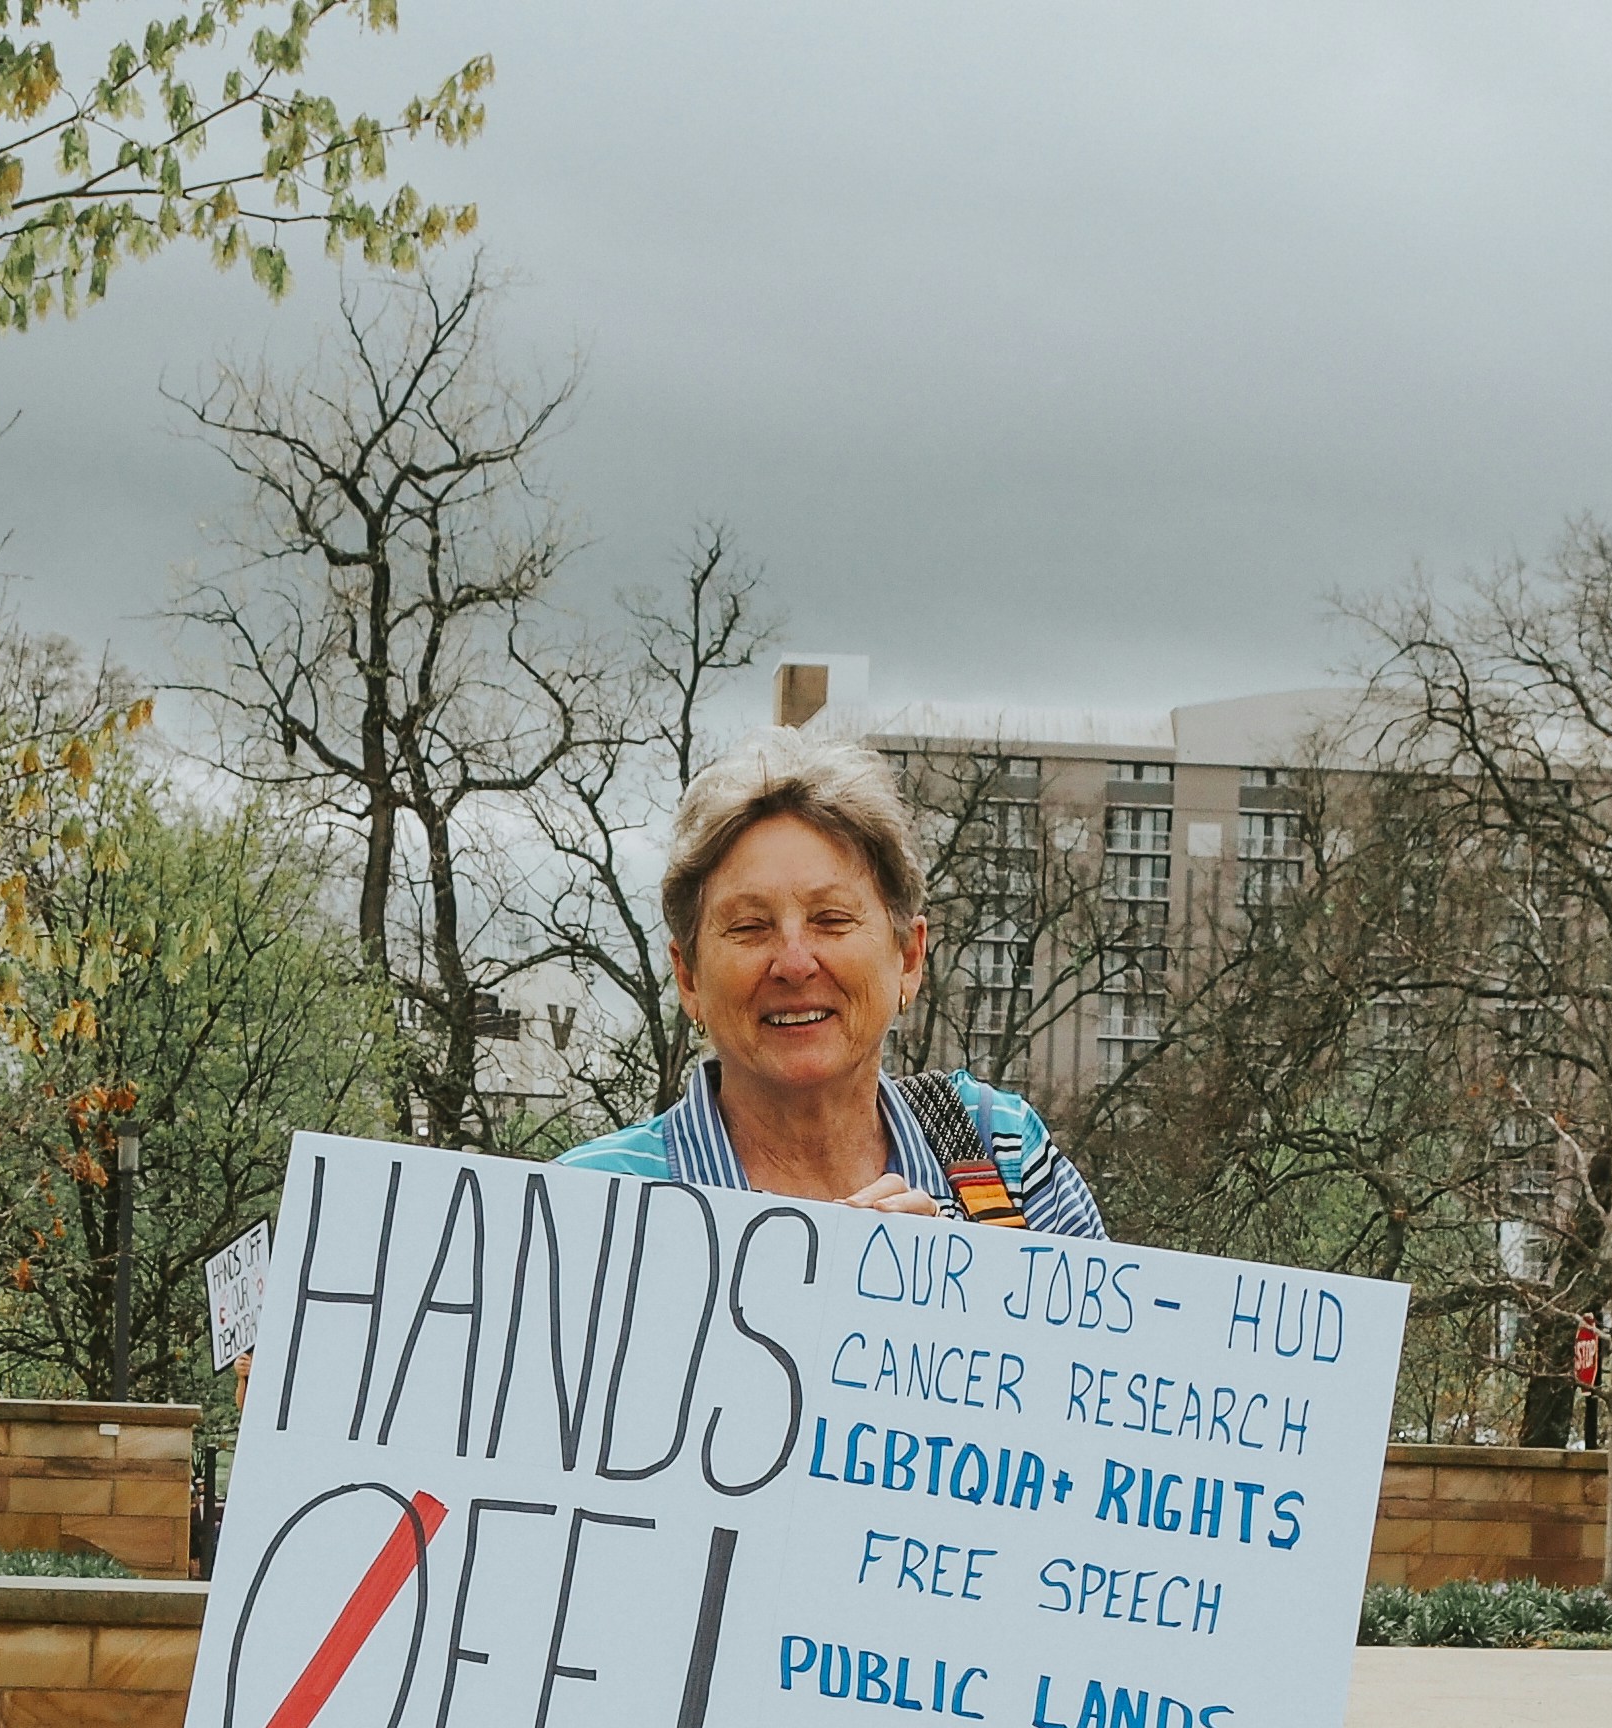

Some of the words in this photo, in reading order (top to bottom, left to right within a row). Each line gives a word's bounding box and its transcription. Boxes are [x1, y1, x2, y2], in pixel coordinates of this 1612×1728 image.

[231, 1276, 250, 1316] OUR
[245, 1228, 262, 1267] OFF
[857, 1223, 974, 1314] OUR
[1227, 1274, 1344, 1365] HUD
[275, 1155, 820, 1496] HANDS
[1575, 1339, 1596, 1371] STOP
[831, 1332, 1026, 1415] CANCER
[1066, 1361, 1311, 1457] RESEARCH
[808, 1416, 1075, 1513] LGBTQIA+
[1094, 1458, 1306, 1552] RIGHTS
[858, 1529, 999, 1602] FREE
[1037, 1558, 1223, 1636] SPEECH
[779, 1635, 990, 1721] PUBLIC
